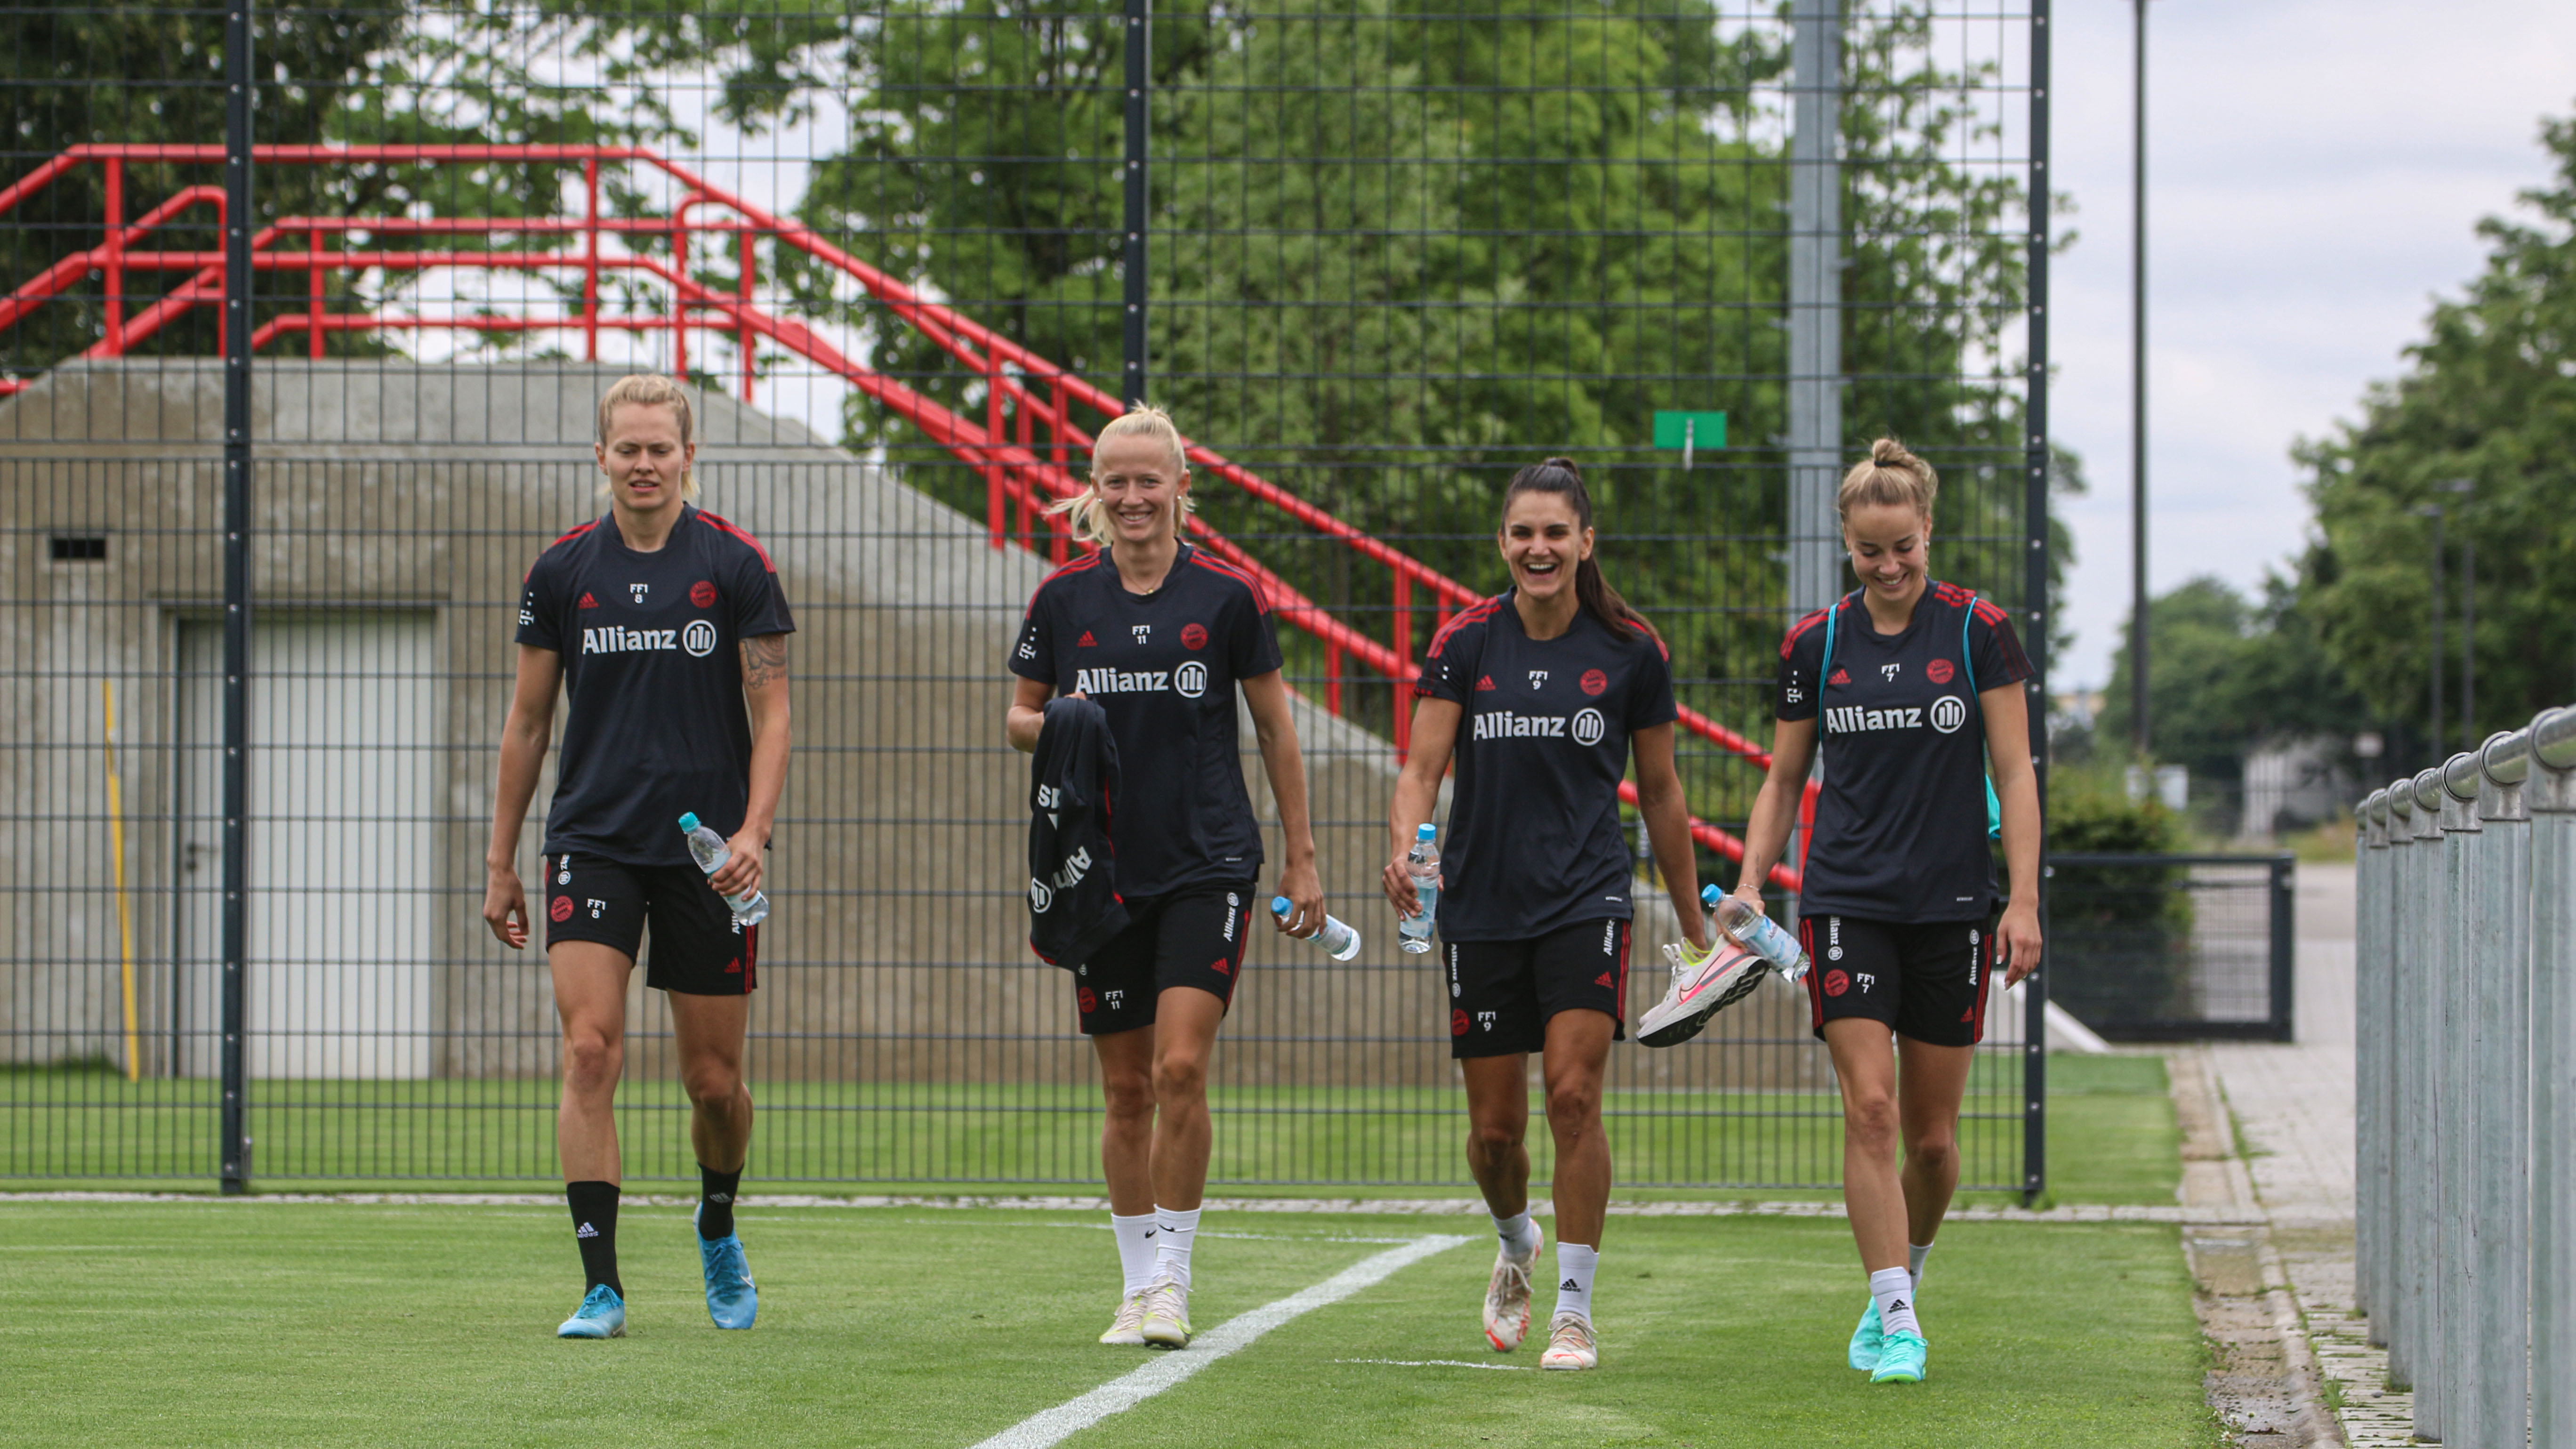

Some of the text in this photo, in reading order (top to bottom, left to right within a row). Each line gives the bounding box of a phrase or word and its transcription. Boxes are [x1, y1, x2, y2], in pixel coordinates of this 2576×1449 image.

[630, 584, 648, 594] FF1
[635, 594, 643, 604] 8
[1132, 625, 1151, 635] FF1
[582, 626, 677, 654] Allianz
[1137, 636, 1146, 644] 11
[1881, 663, 1900, 674] FF1
[1528, 670, 1548, 681] FF1
[1887, 673, 1894, 682] 7
[1076, 668, 1168, 695] Allianz
[1532, 680, 1541, 690] 9
[1826, 706, 1922, 733] Allianz
[1473, 711, 1566, 741] Allianz
[587, 898, 606, 910] FF1
[591, 909, 600, 919] 8
[1223, 907, 1236, 942] Allianz
[1603, 919, 1615, 956] Allianz
[1969, 947, 1978, 986] Allianz
[1857, 973, 1875, 985] FF1
[1862, 984, 1869, 994] 7
[1105, 990, 1123, 1001] FF1
[1111, 1001, 1120, 1010] 11
[1478, 1011, 1496, 1022] FF1
[1483, 1022, 1491, 1031] 9
